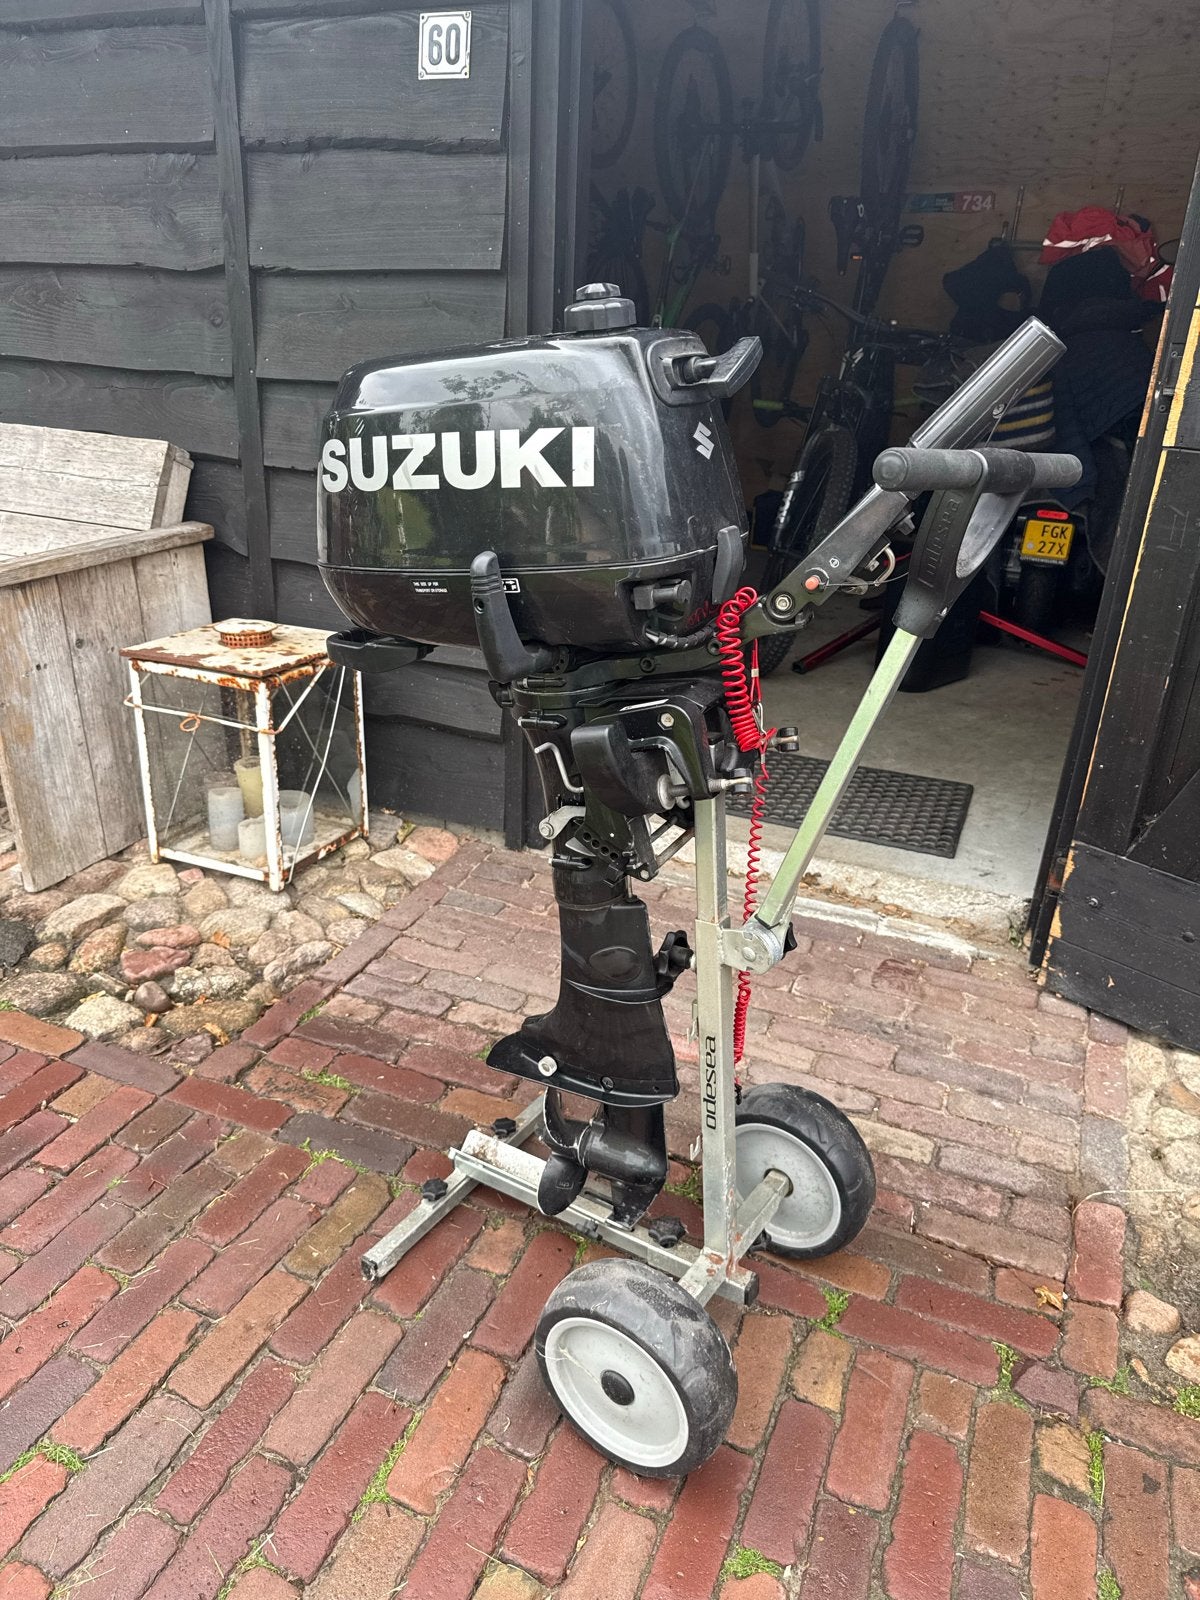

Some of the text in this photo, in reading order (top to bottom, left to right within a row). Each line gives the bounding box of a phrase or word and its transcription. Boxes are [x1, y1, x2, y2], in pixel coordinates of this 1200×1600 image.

[428, 23, 461, 66] 60
[962, 195, 992, 211] 734
[321, 426, 595, 493] SUZUKI
[1041, 524, 1069, 540] FGK
[1037, 540, 1065, 556] 27X
[702, 1035, 717, 1130] odesea
